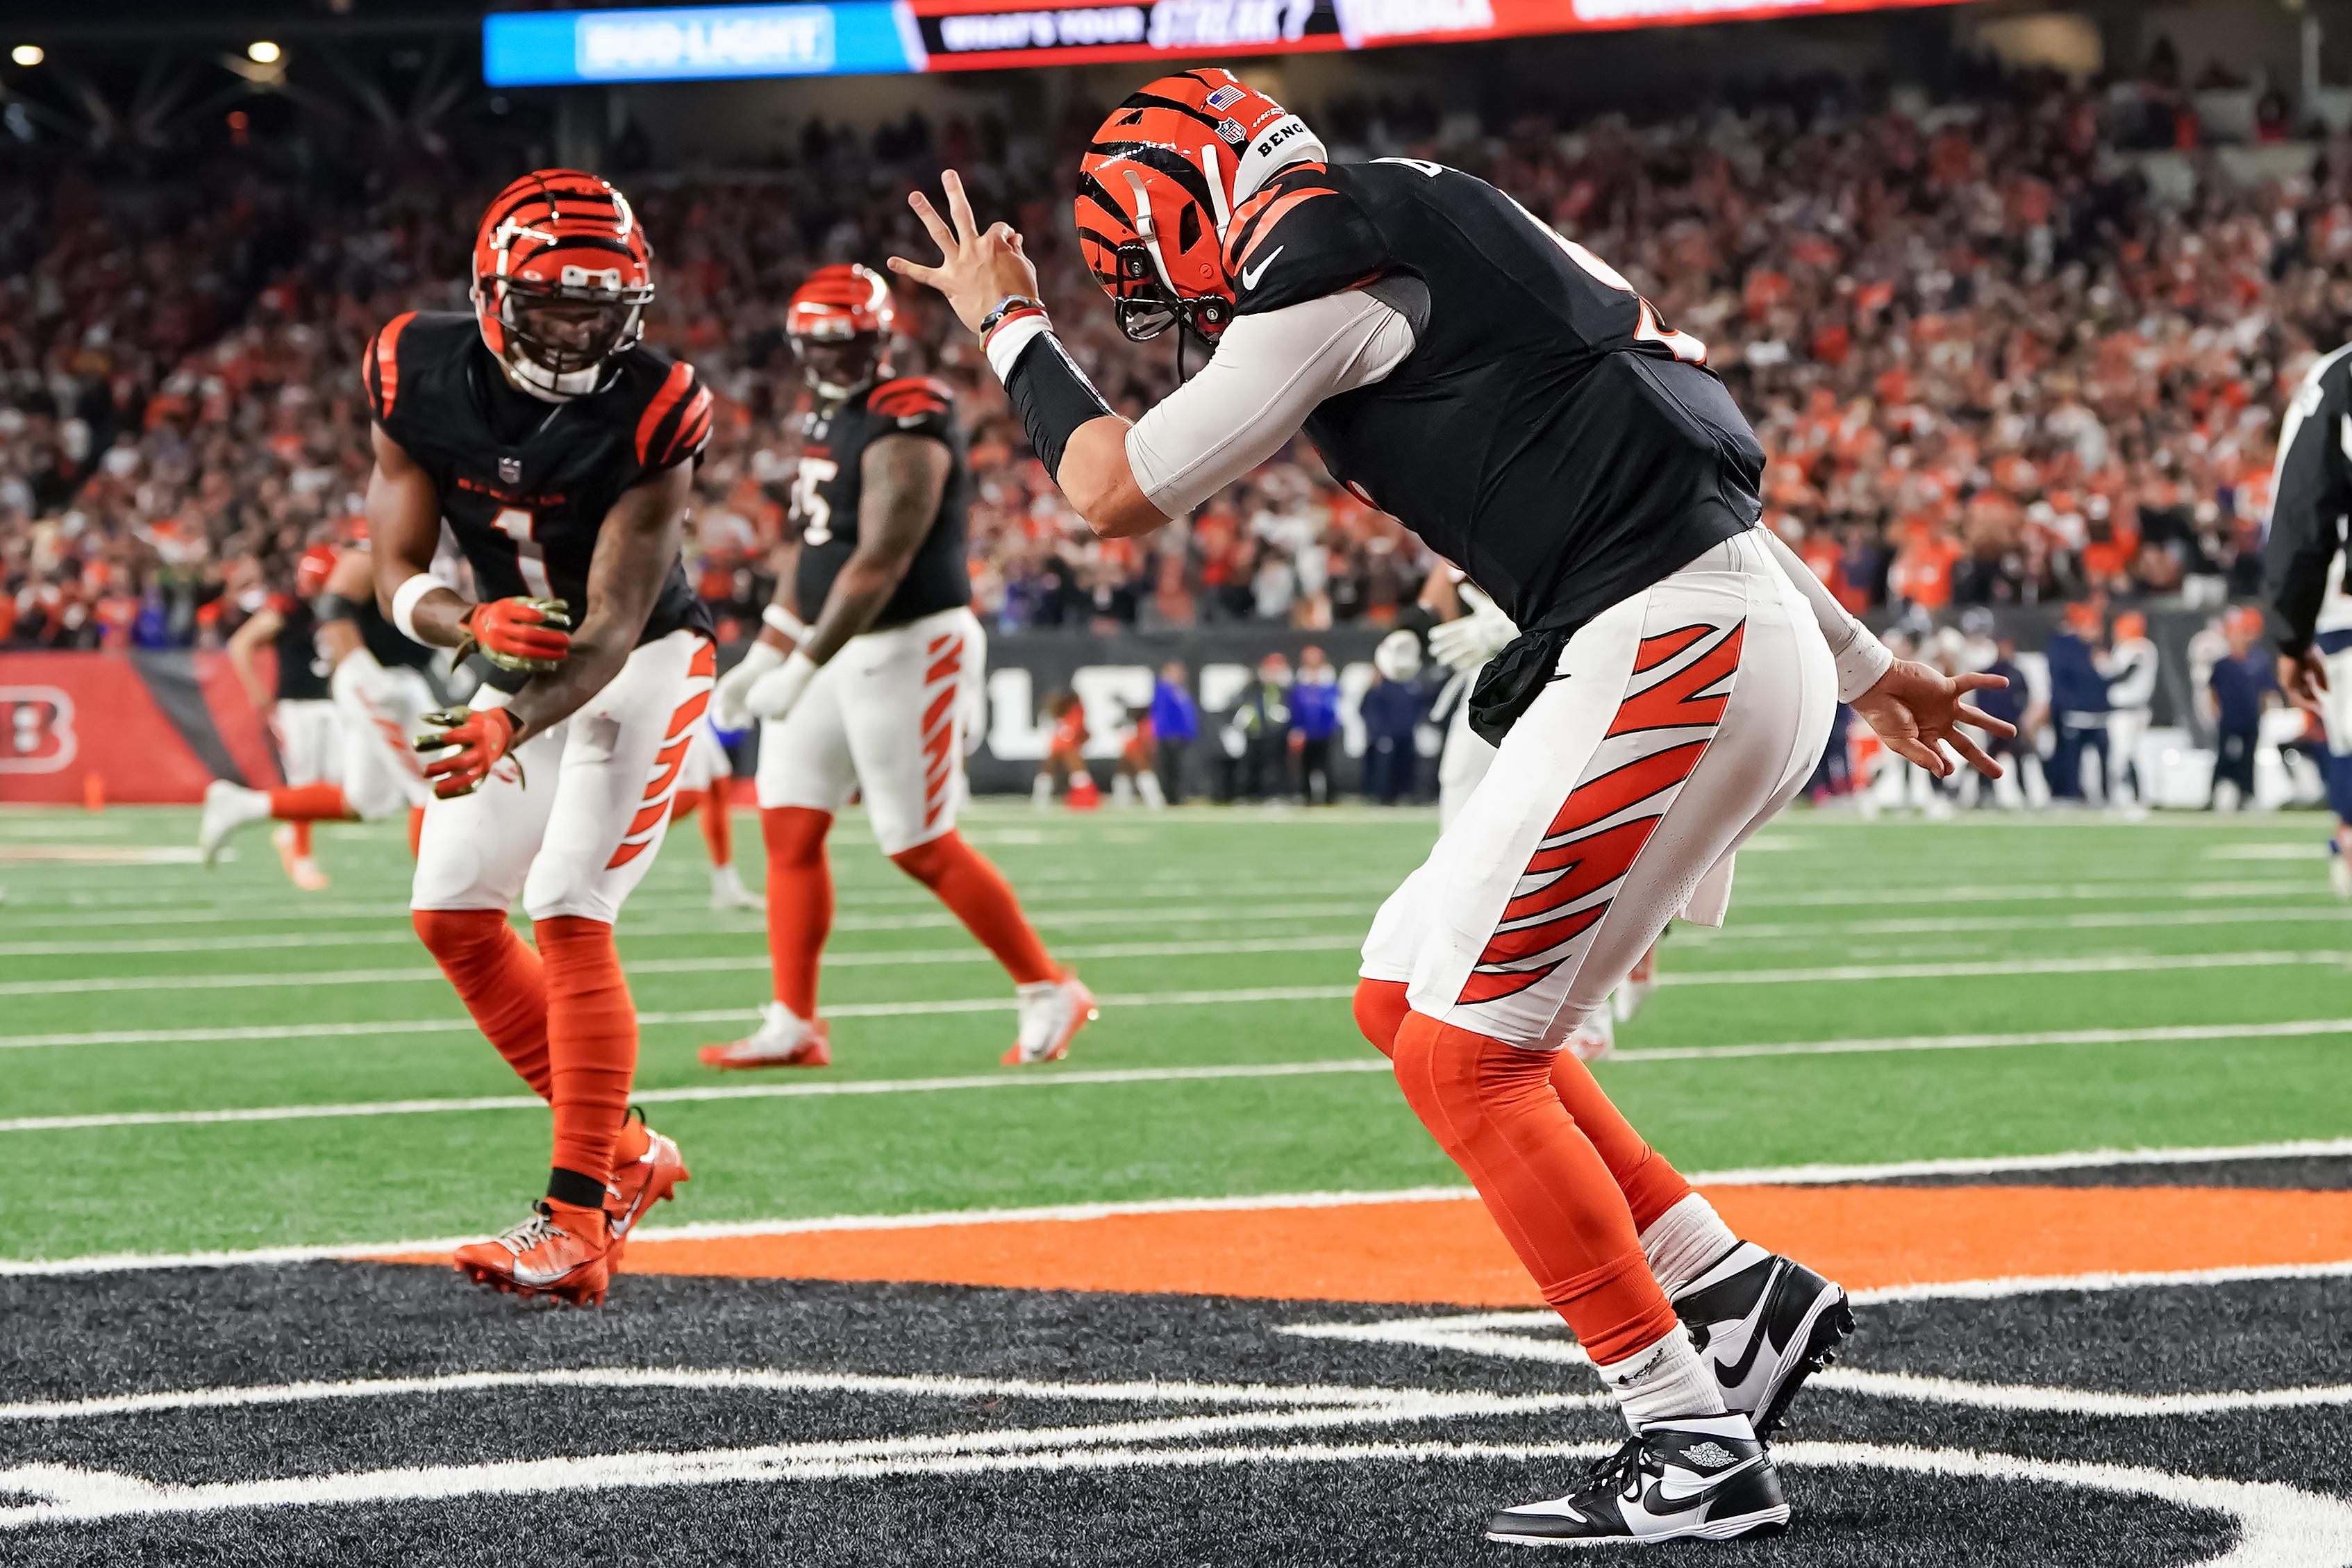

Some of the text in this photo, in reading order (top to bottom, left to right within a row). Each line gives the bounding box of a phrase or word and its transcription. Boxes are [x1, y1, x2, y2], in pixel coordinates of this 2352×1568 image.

[687, 16, 818, 65] LIGHT
[940, 11, 1057, 51] WHAT'S
[1058, 6, 1144, 45] YOUR
[1258, 123, 1307, 157] BENG
[490, 506, 556, 601] 1
